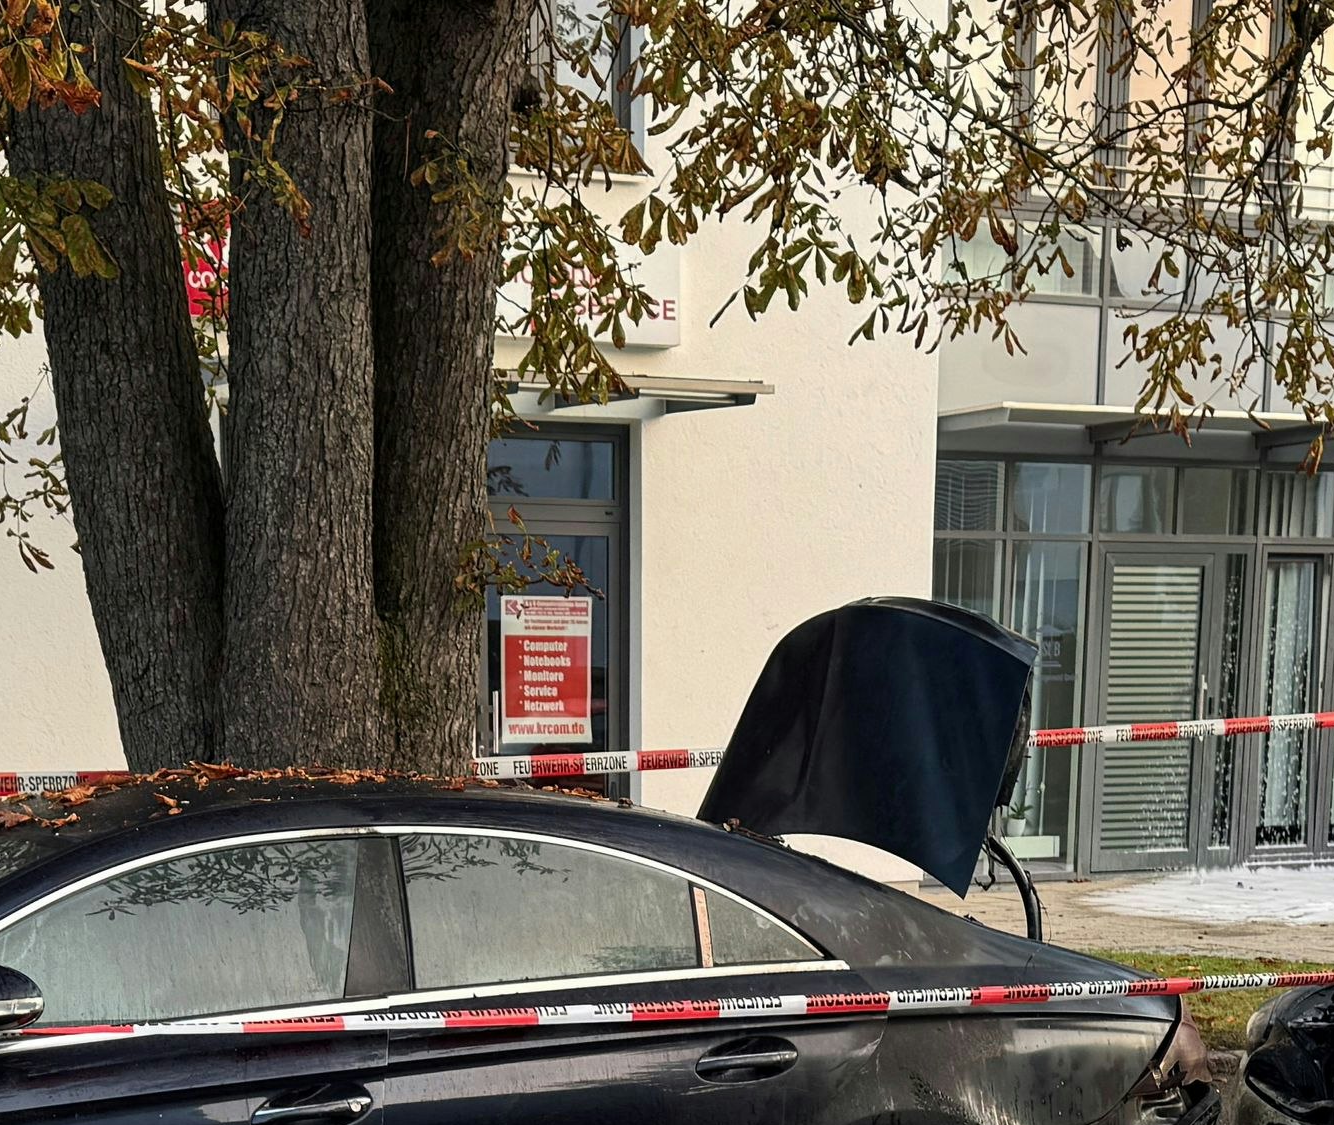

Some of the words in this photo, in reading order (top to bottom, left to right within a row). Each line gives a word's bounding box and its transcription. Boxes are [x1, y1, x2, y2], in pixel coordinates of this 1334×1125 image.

[524, 640, 567, 653] Computer
[524, 656, 571, 667] Notebooks
[524, 670, 564, 682] Monitore
[524, 685, 558, 697] Service
[524, 700, 564, 712] Netzwerk
[513, 755, 627, 776] FEUERWEHR-SPERRZONE
